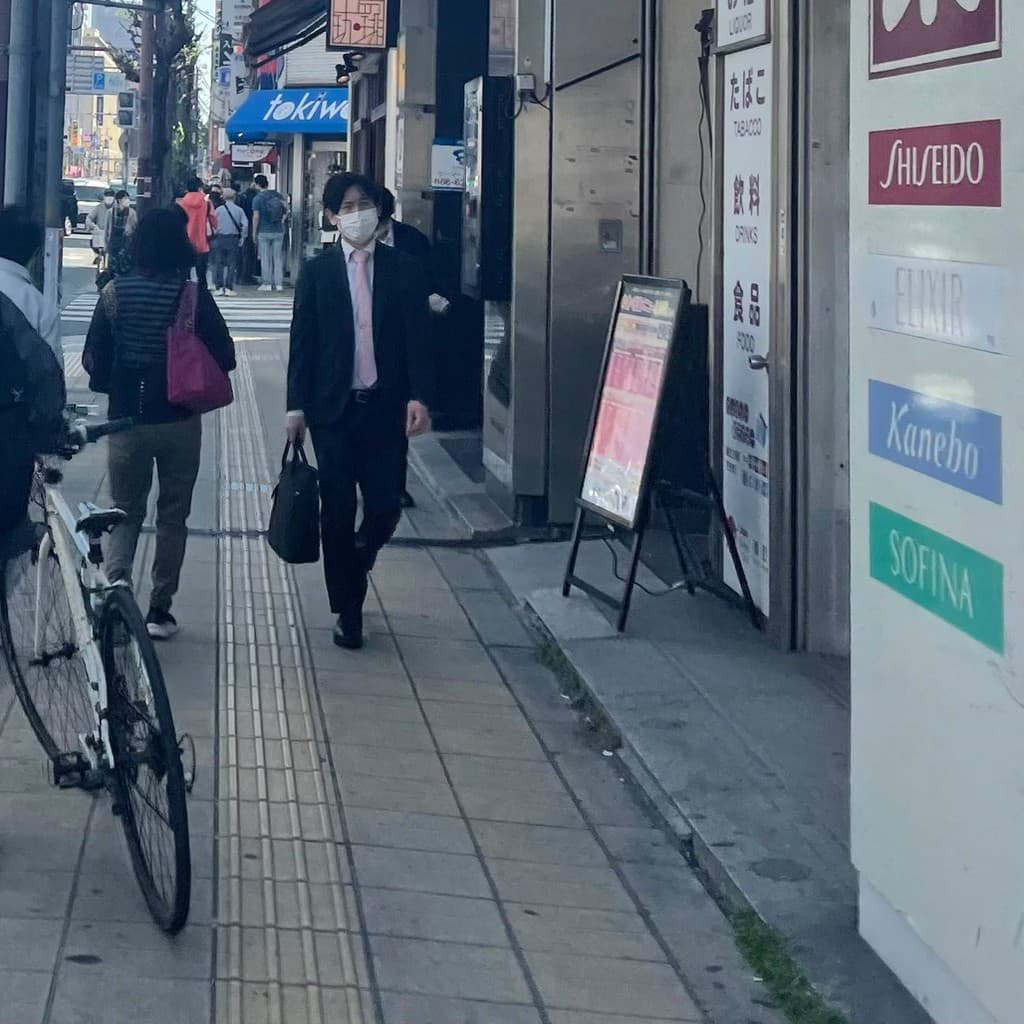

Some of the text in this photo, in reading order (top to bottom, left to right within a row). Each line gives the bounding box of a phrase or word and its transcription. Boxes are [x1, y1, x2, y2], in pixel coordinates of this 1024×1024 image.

[729, 12, 752, 36] LIQUOR
[730, 67, 765, 111] たばこ
[880, 139, 984, 189] SHISEIDO
[733, 173, 760, 216] 飲料
[735, 225, 758, 245] DRINKS
[733, 280, 760, 326] 食品
[895, 266, 964, 337] ELIXIR
[736, 330, 755, 354] FOOD
[887, 401, 979, 479] Kanebo
[890, 529, 974, 619] SOFINA
